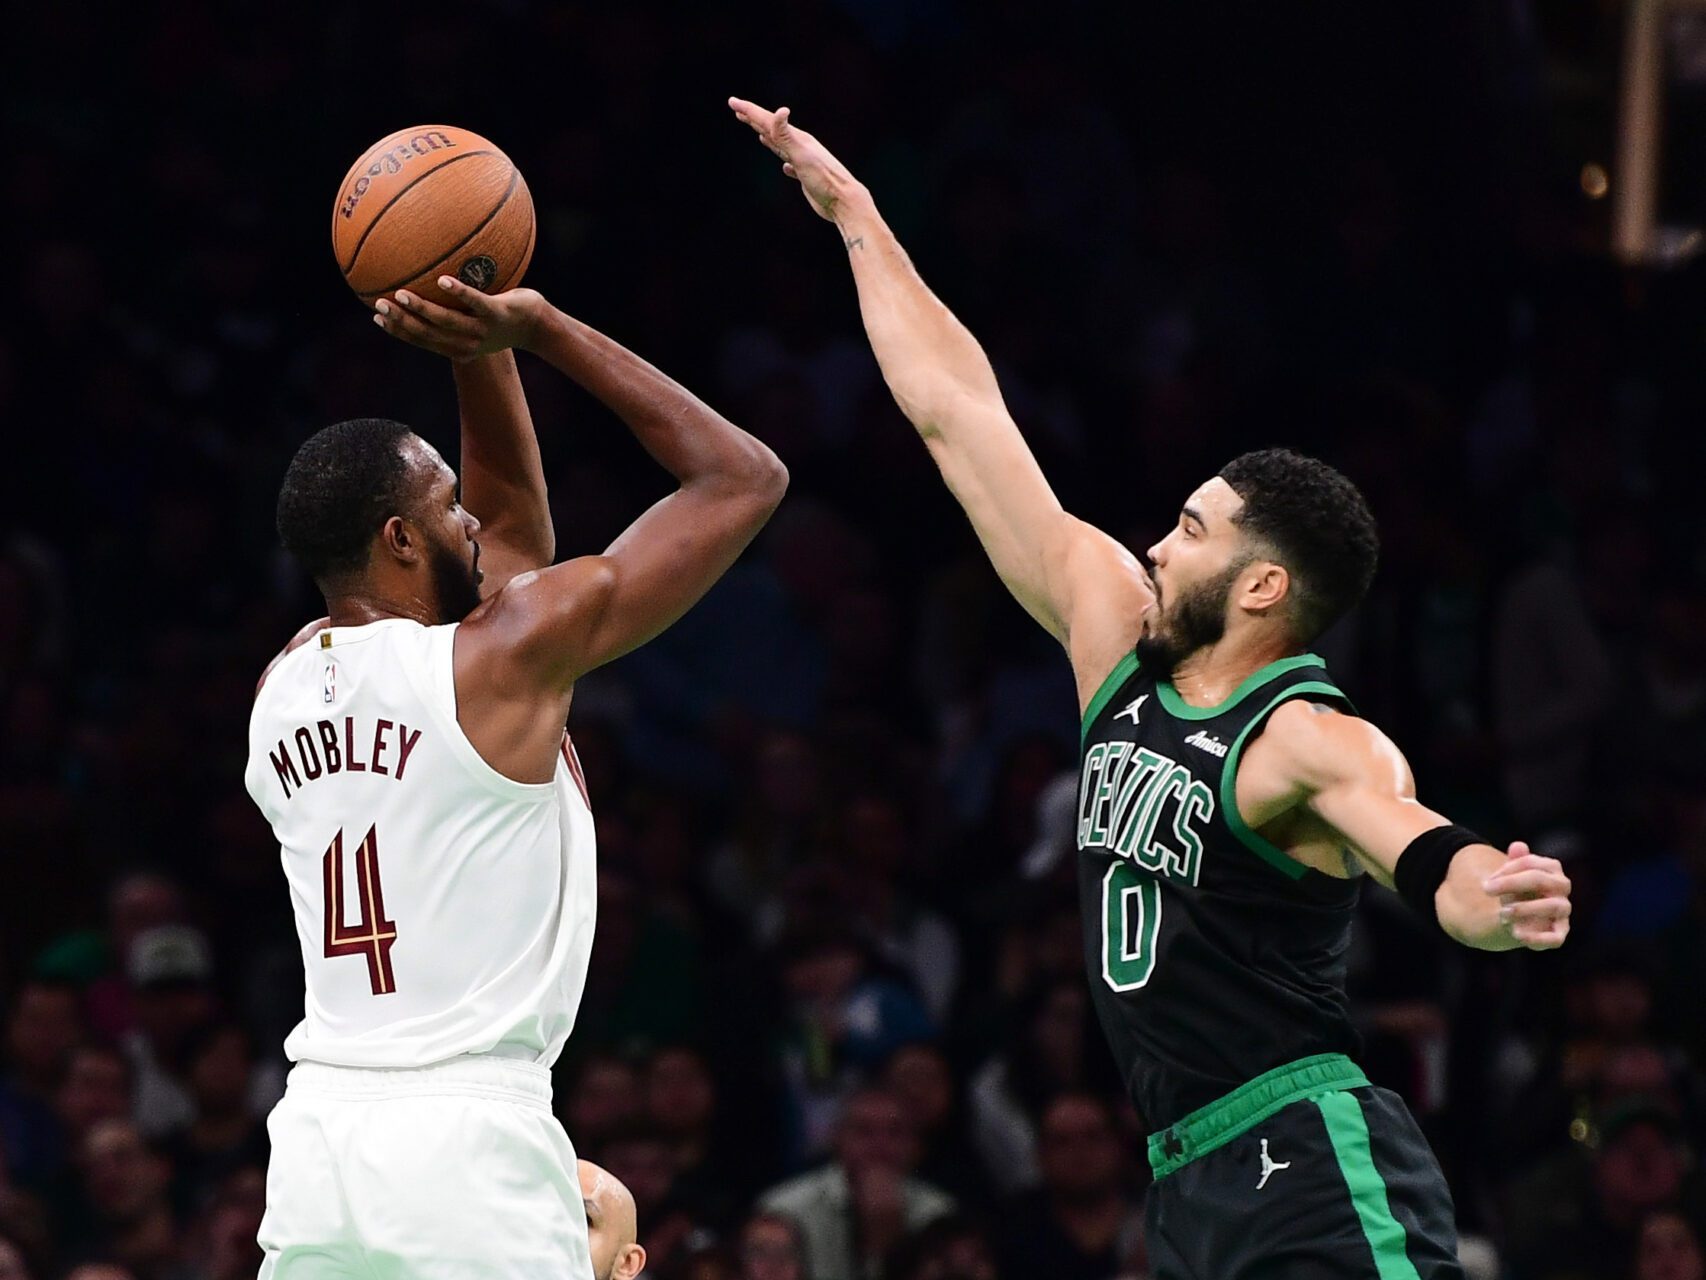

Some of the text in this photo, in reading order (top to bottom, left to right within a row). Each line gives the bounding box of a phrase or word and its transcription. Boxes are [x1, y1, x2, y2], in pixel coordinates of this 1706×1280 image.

[340, 131, 456, 219] Wilson
[269, 716, 422, 800] MOBLEY
[1184, 730, 1229, 758] Amica
[1077, 741, 1215, 888] CELTICS
[323, 822, 397, 996] 4
[1102, 860, 1162, 993] 0
